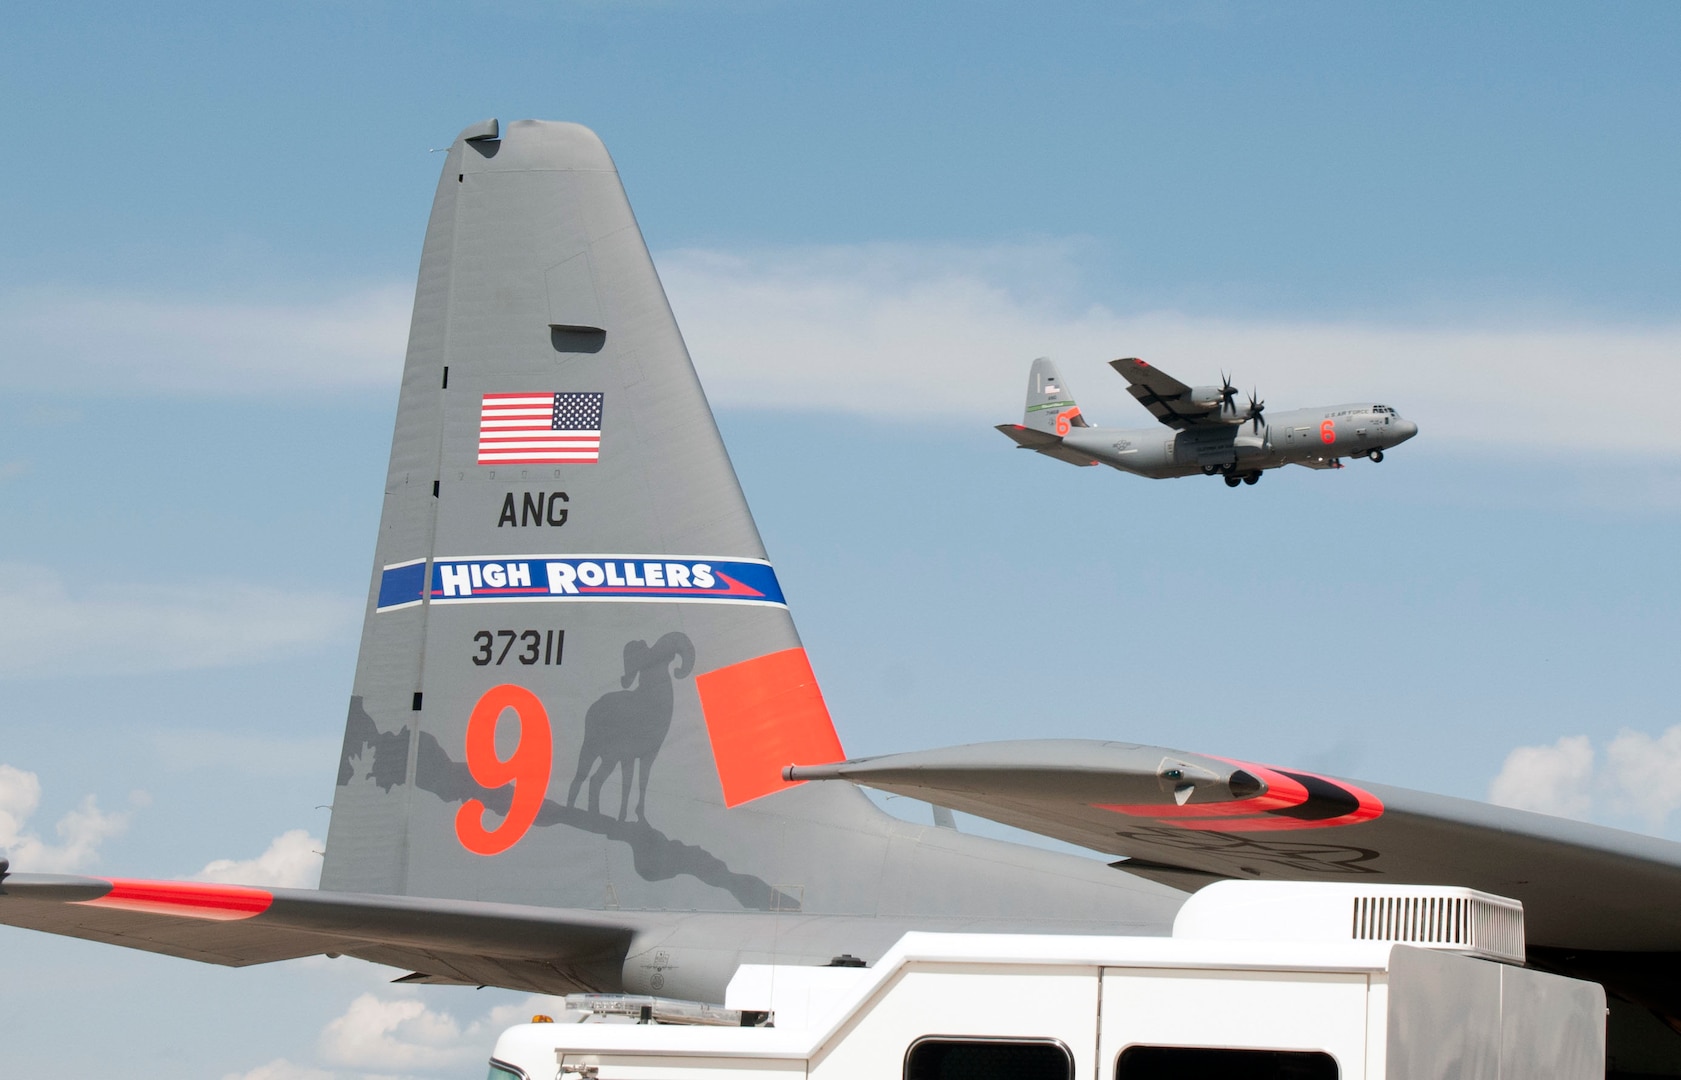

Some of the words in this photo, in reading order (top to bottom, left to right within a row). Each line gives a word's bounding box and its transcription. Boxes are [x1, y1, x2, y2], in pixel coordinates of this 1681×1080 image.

[1056, 412, 1070, 437] 6
[1319, 419, 1337, 445] 6
[497, 491, 570, 528] ANG
[440, 562, 532, 597] HIGH
[546, 561, 716, 595] ROLLERS
[471, 629, 565, 667] 37311
[454, 683, 554, 857] 9
